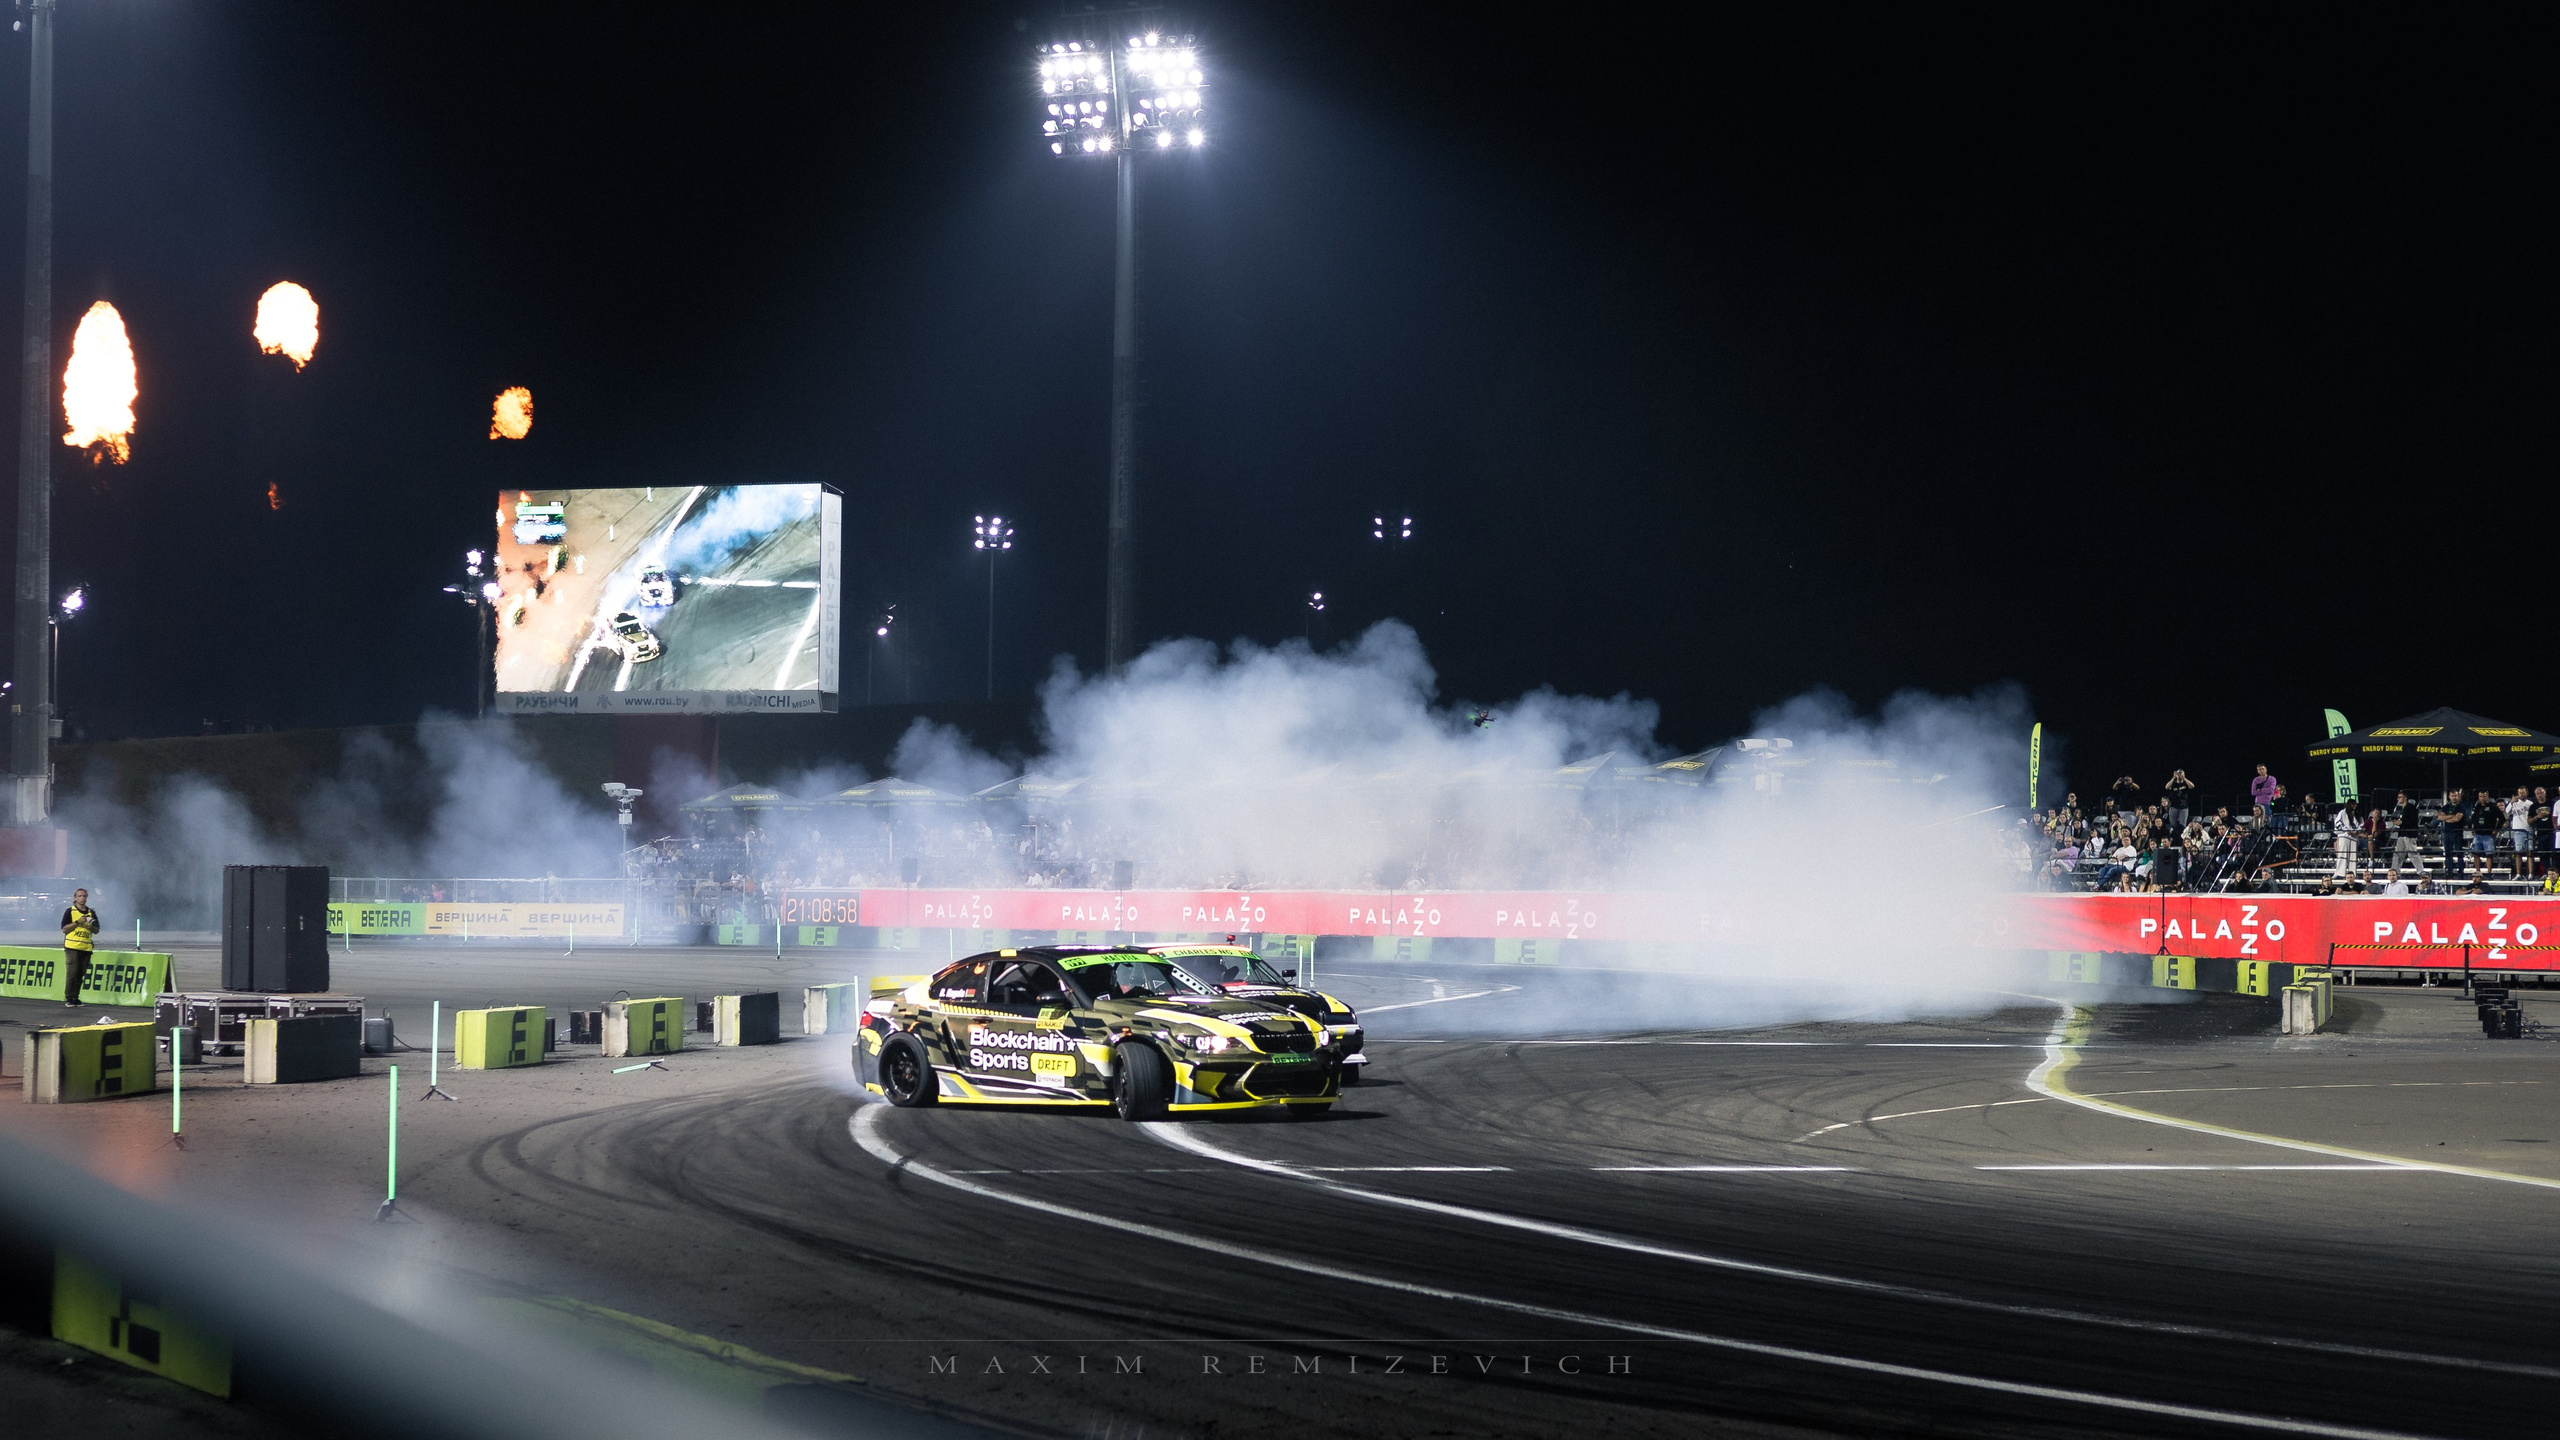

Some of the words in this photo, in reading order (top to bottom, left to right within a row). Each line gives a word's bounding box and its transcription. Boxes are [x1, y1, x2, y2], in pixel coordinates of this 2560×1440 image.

[515, 696, 579, 709] РАУБИЧИ
[624, 696, 689, 708] www.rau.by
[792, 698, 816, 709] MEDIA
[2310, 748, 2330, 756] ENERGY
[787, 898, 857, 923] 21:08:58
[361, 910, 411, 928] BETERA
[435, 911, 509, 923] ВЕРШИНА
[528, 912, 616, 924] ВЕРШИНА
[82, 963, 147, 993] BETERA
[970, 1028, 1064, 1052] Blockchain
[969, 1048, 1029, 1071] Sports
[1038, 1059, 1069, 1071] DRIFT
